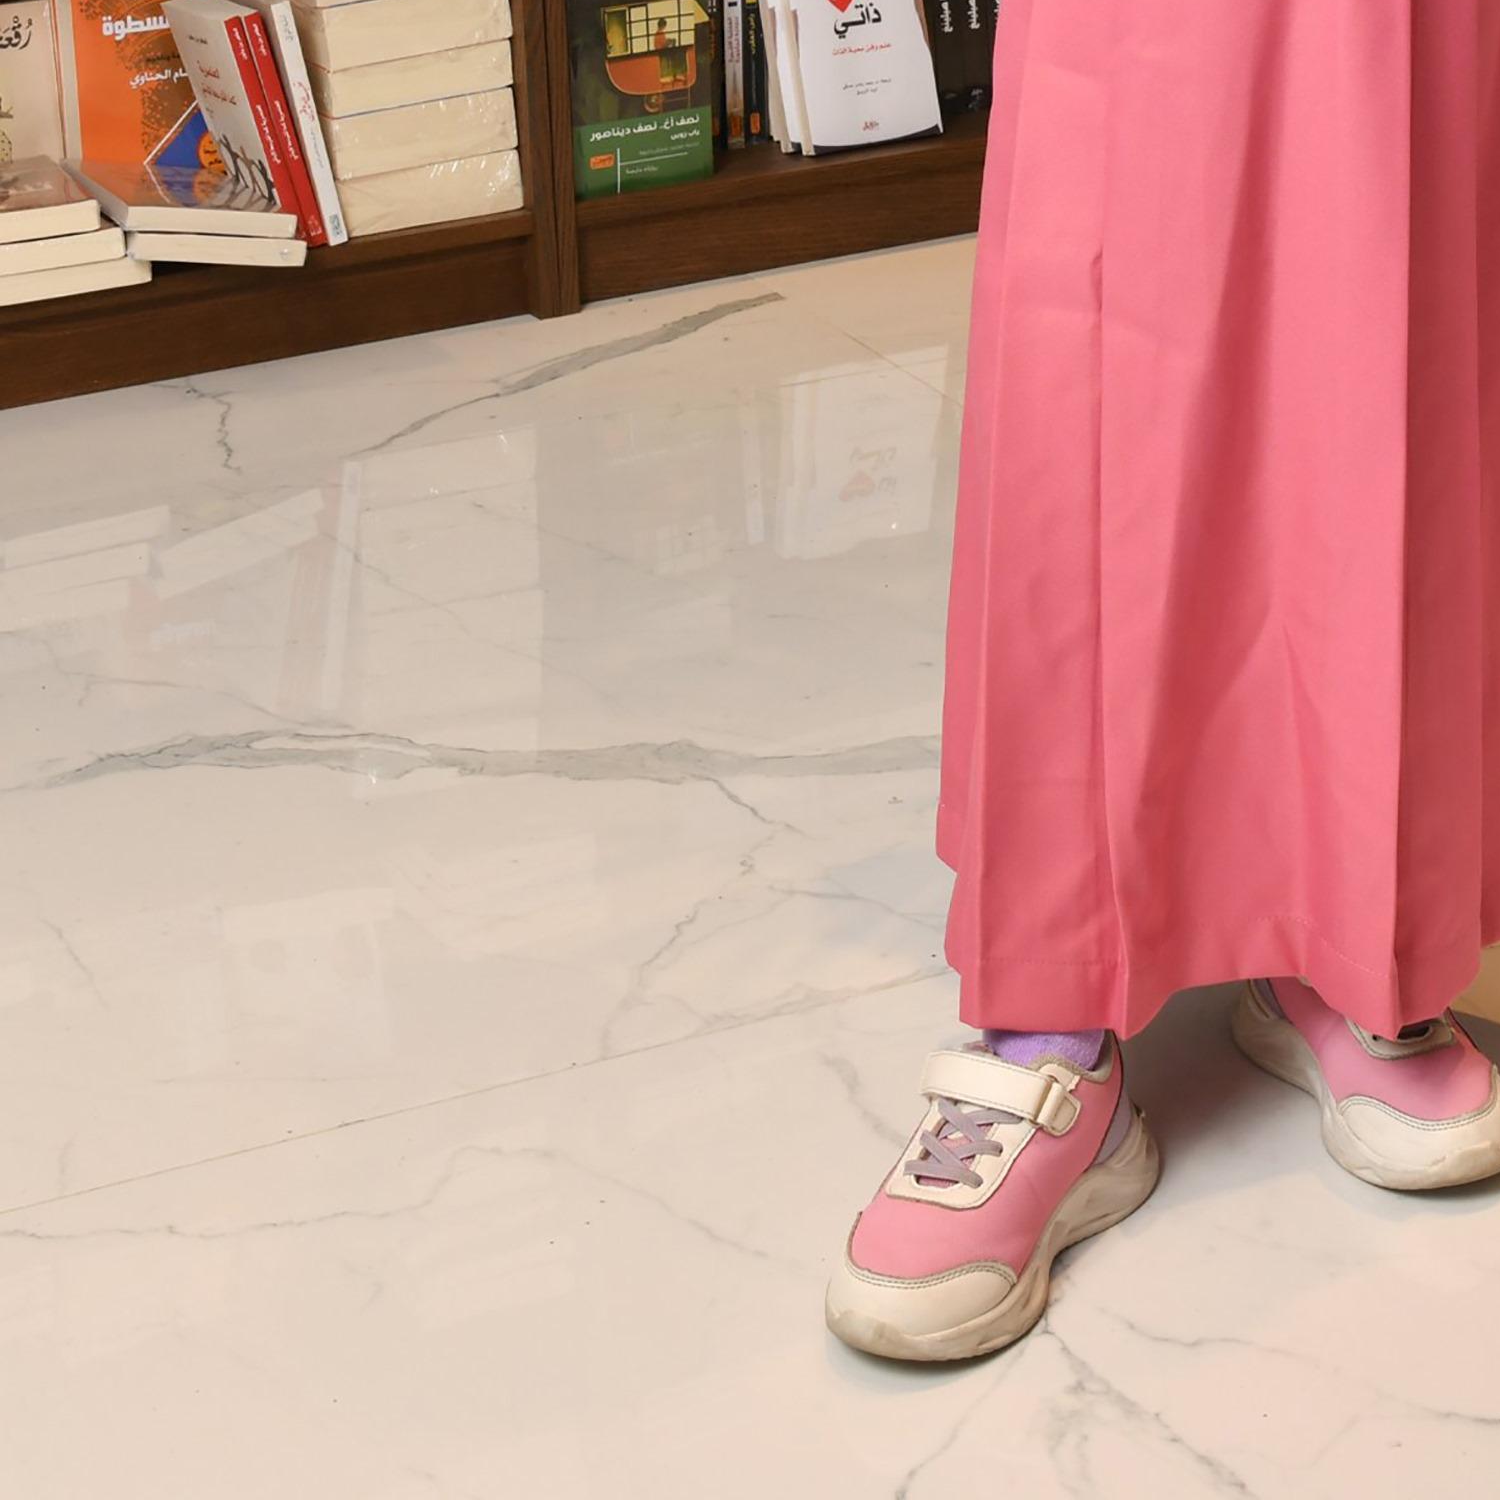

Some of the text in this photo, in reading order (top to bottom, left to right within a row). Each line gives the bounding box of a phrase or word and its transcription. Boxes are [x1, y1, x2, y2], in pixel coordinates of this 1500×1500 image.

[101, 13, 170, 42] سطوة
[833, 2, 882, 40] ذاتي
[128, 69, 172, 89] الحناوي
[632, 121, 658, 134] نصف
[676, 113, 700, 127] نصف
[589, 128, 632, 143] ديناصور
